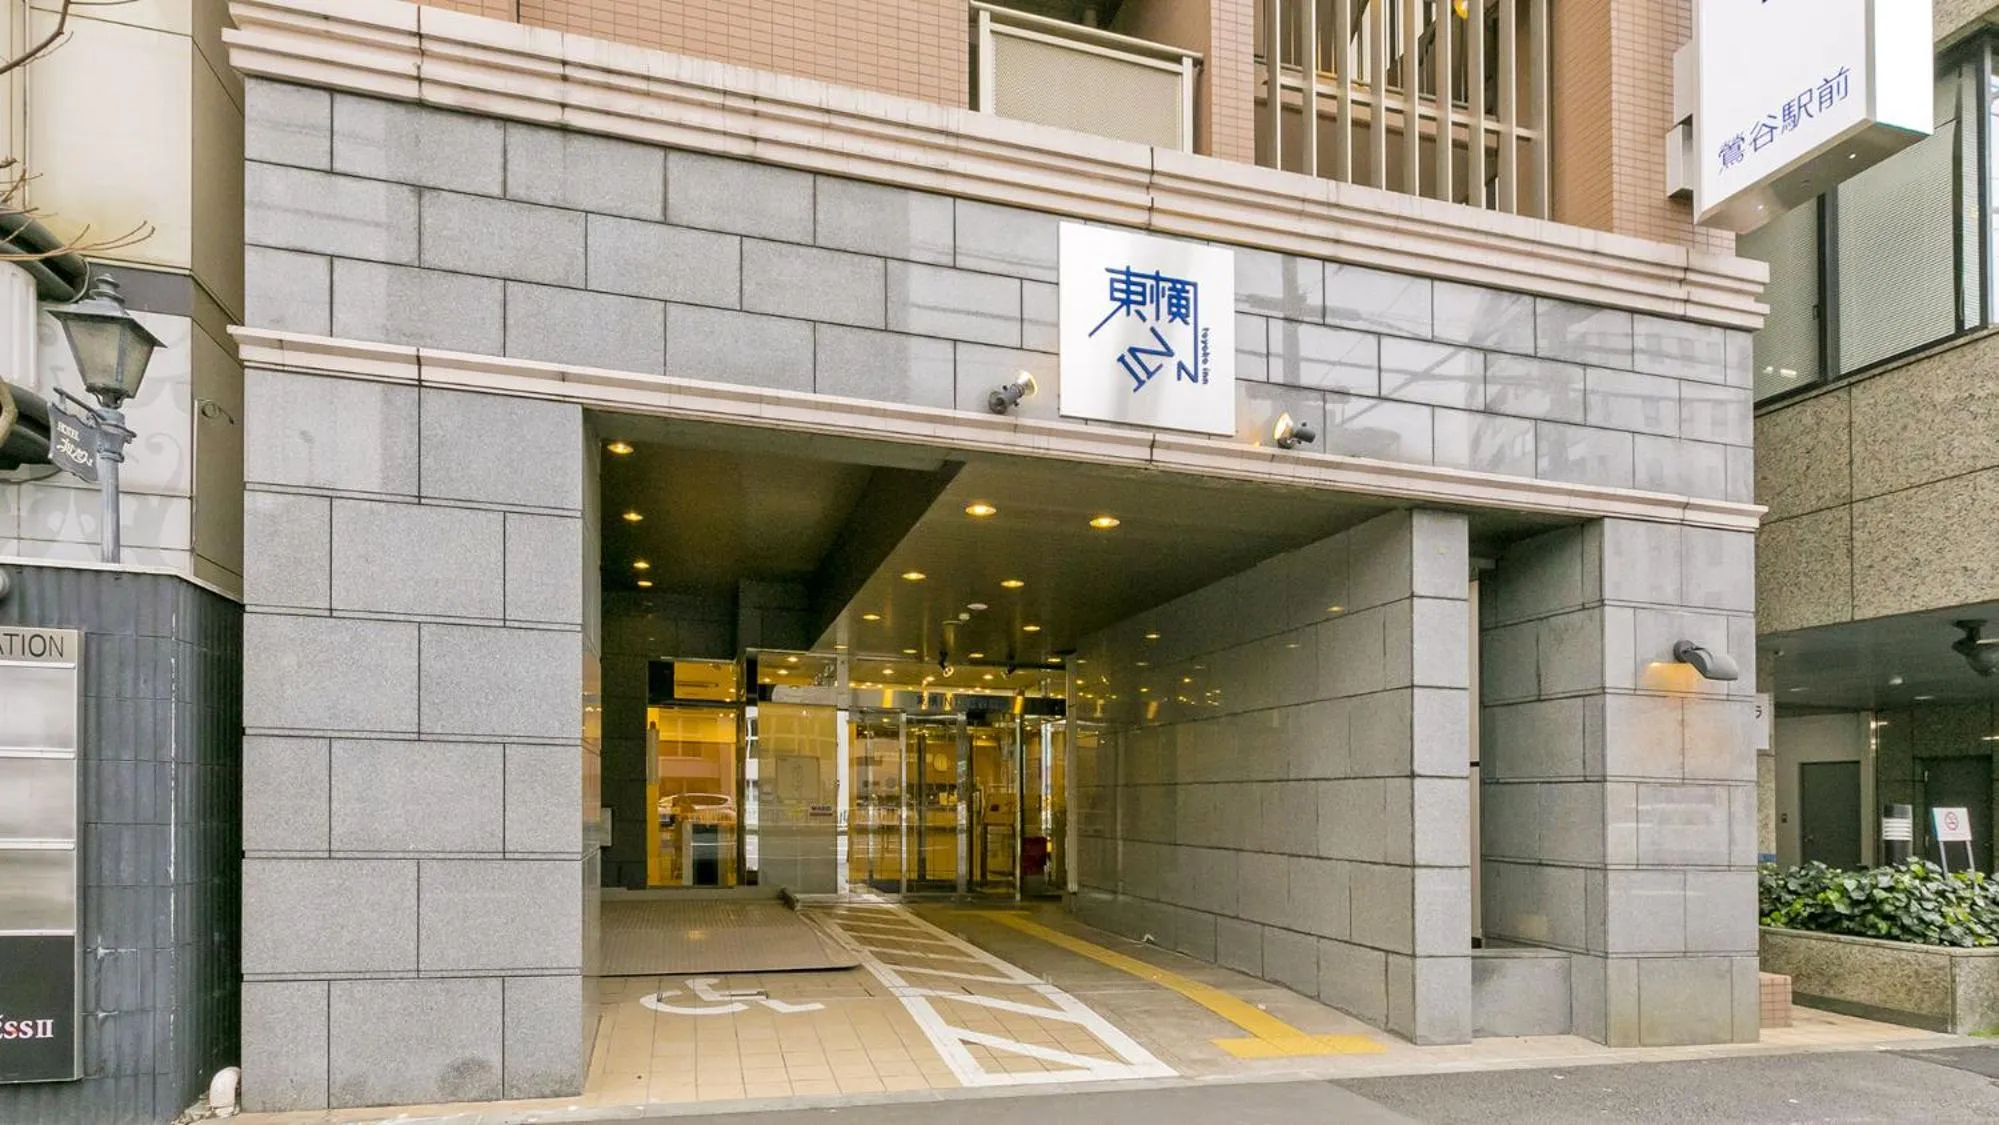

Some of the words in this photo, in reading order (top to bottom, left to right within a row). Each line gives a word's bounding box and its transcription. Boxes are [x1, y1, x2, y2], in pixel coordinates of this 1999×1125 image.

[1717, 65, 1850, 175] 鶯谷駅前
[1200, 327, 1210, 365] toyoko
[1201, 367, 1210, 385] inn
[0, 632, 64, 658] TION
